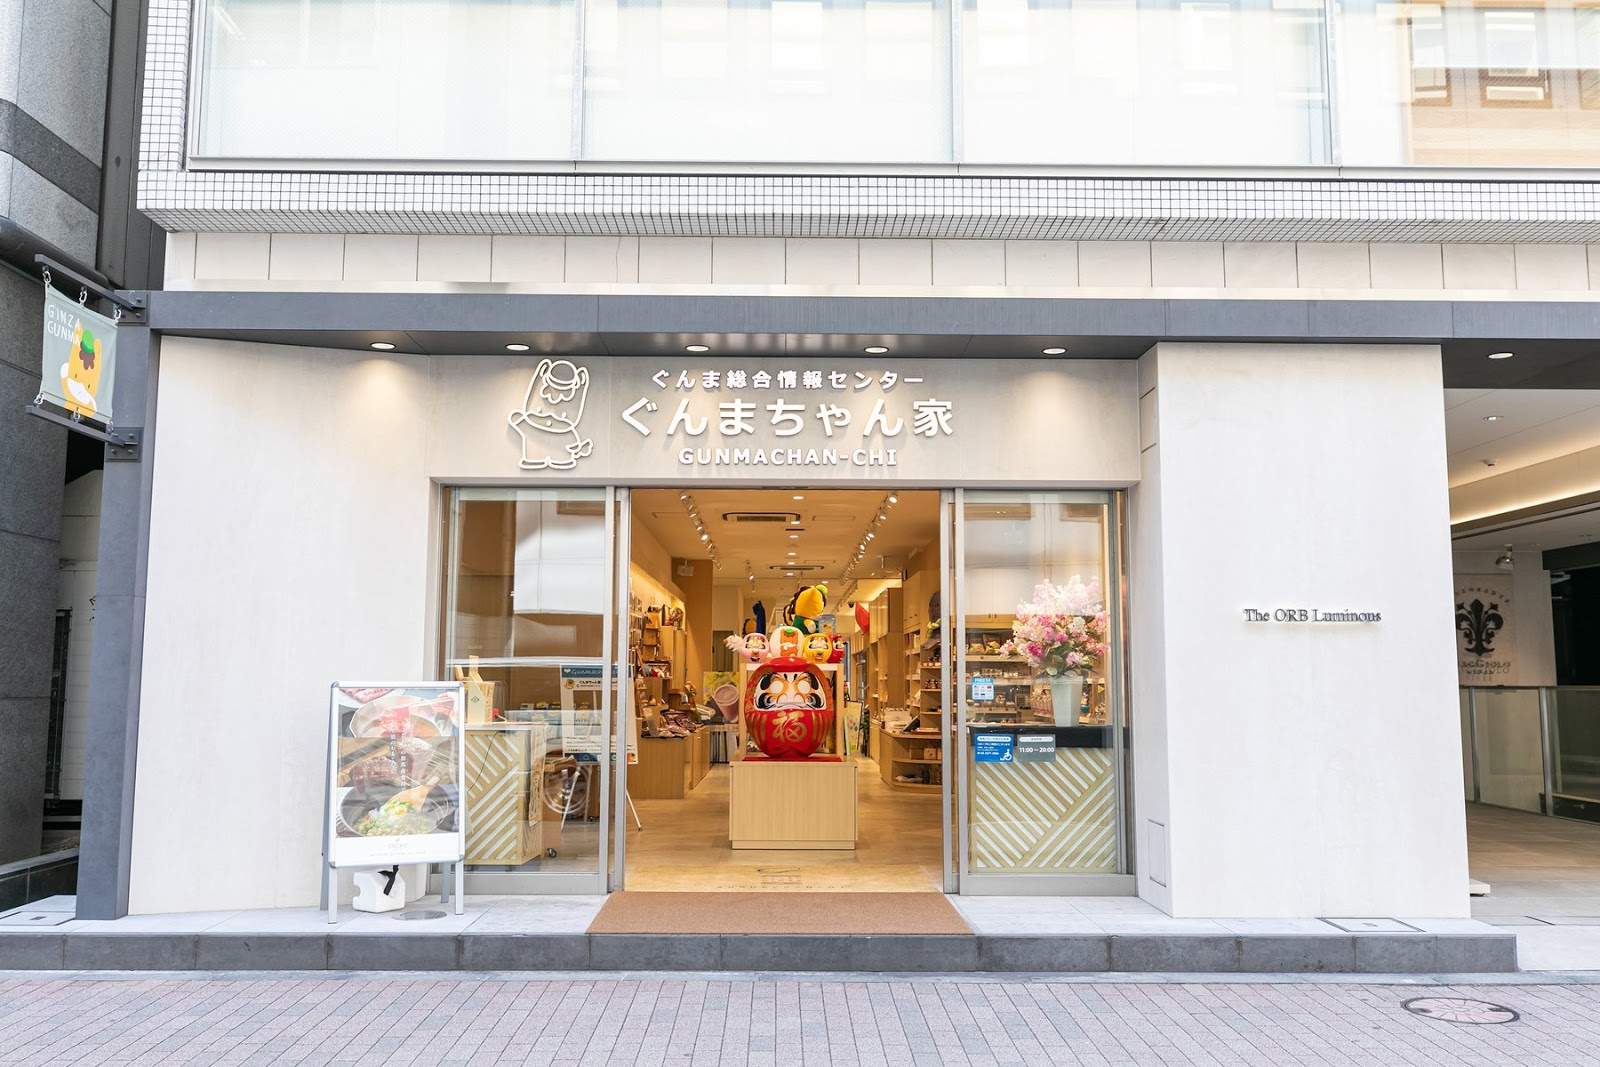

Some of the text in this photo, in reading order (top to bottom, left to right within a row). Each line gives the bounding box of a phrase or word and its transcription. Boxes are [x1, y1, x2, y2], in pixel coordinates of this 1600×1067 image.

[48, 304, 82, 332] GINZA
[47, 320, 81, 346] GUNMA
[651, 370, 925, 390] ぐんま総合情報センター
[620, 397, 955, 437] ぐんまちゃん家
[678, 447, 898, 467] GUNMACHAN-CHI
[1244, 608, 1382, 622] The ORB Luminous
[772, 710, 807, 743] 福
